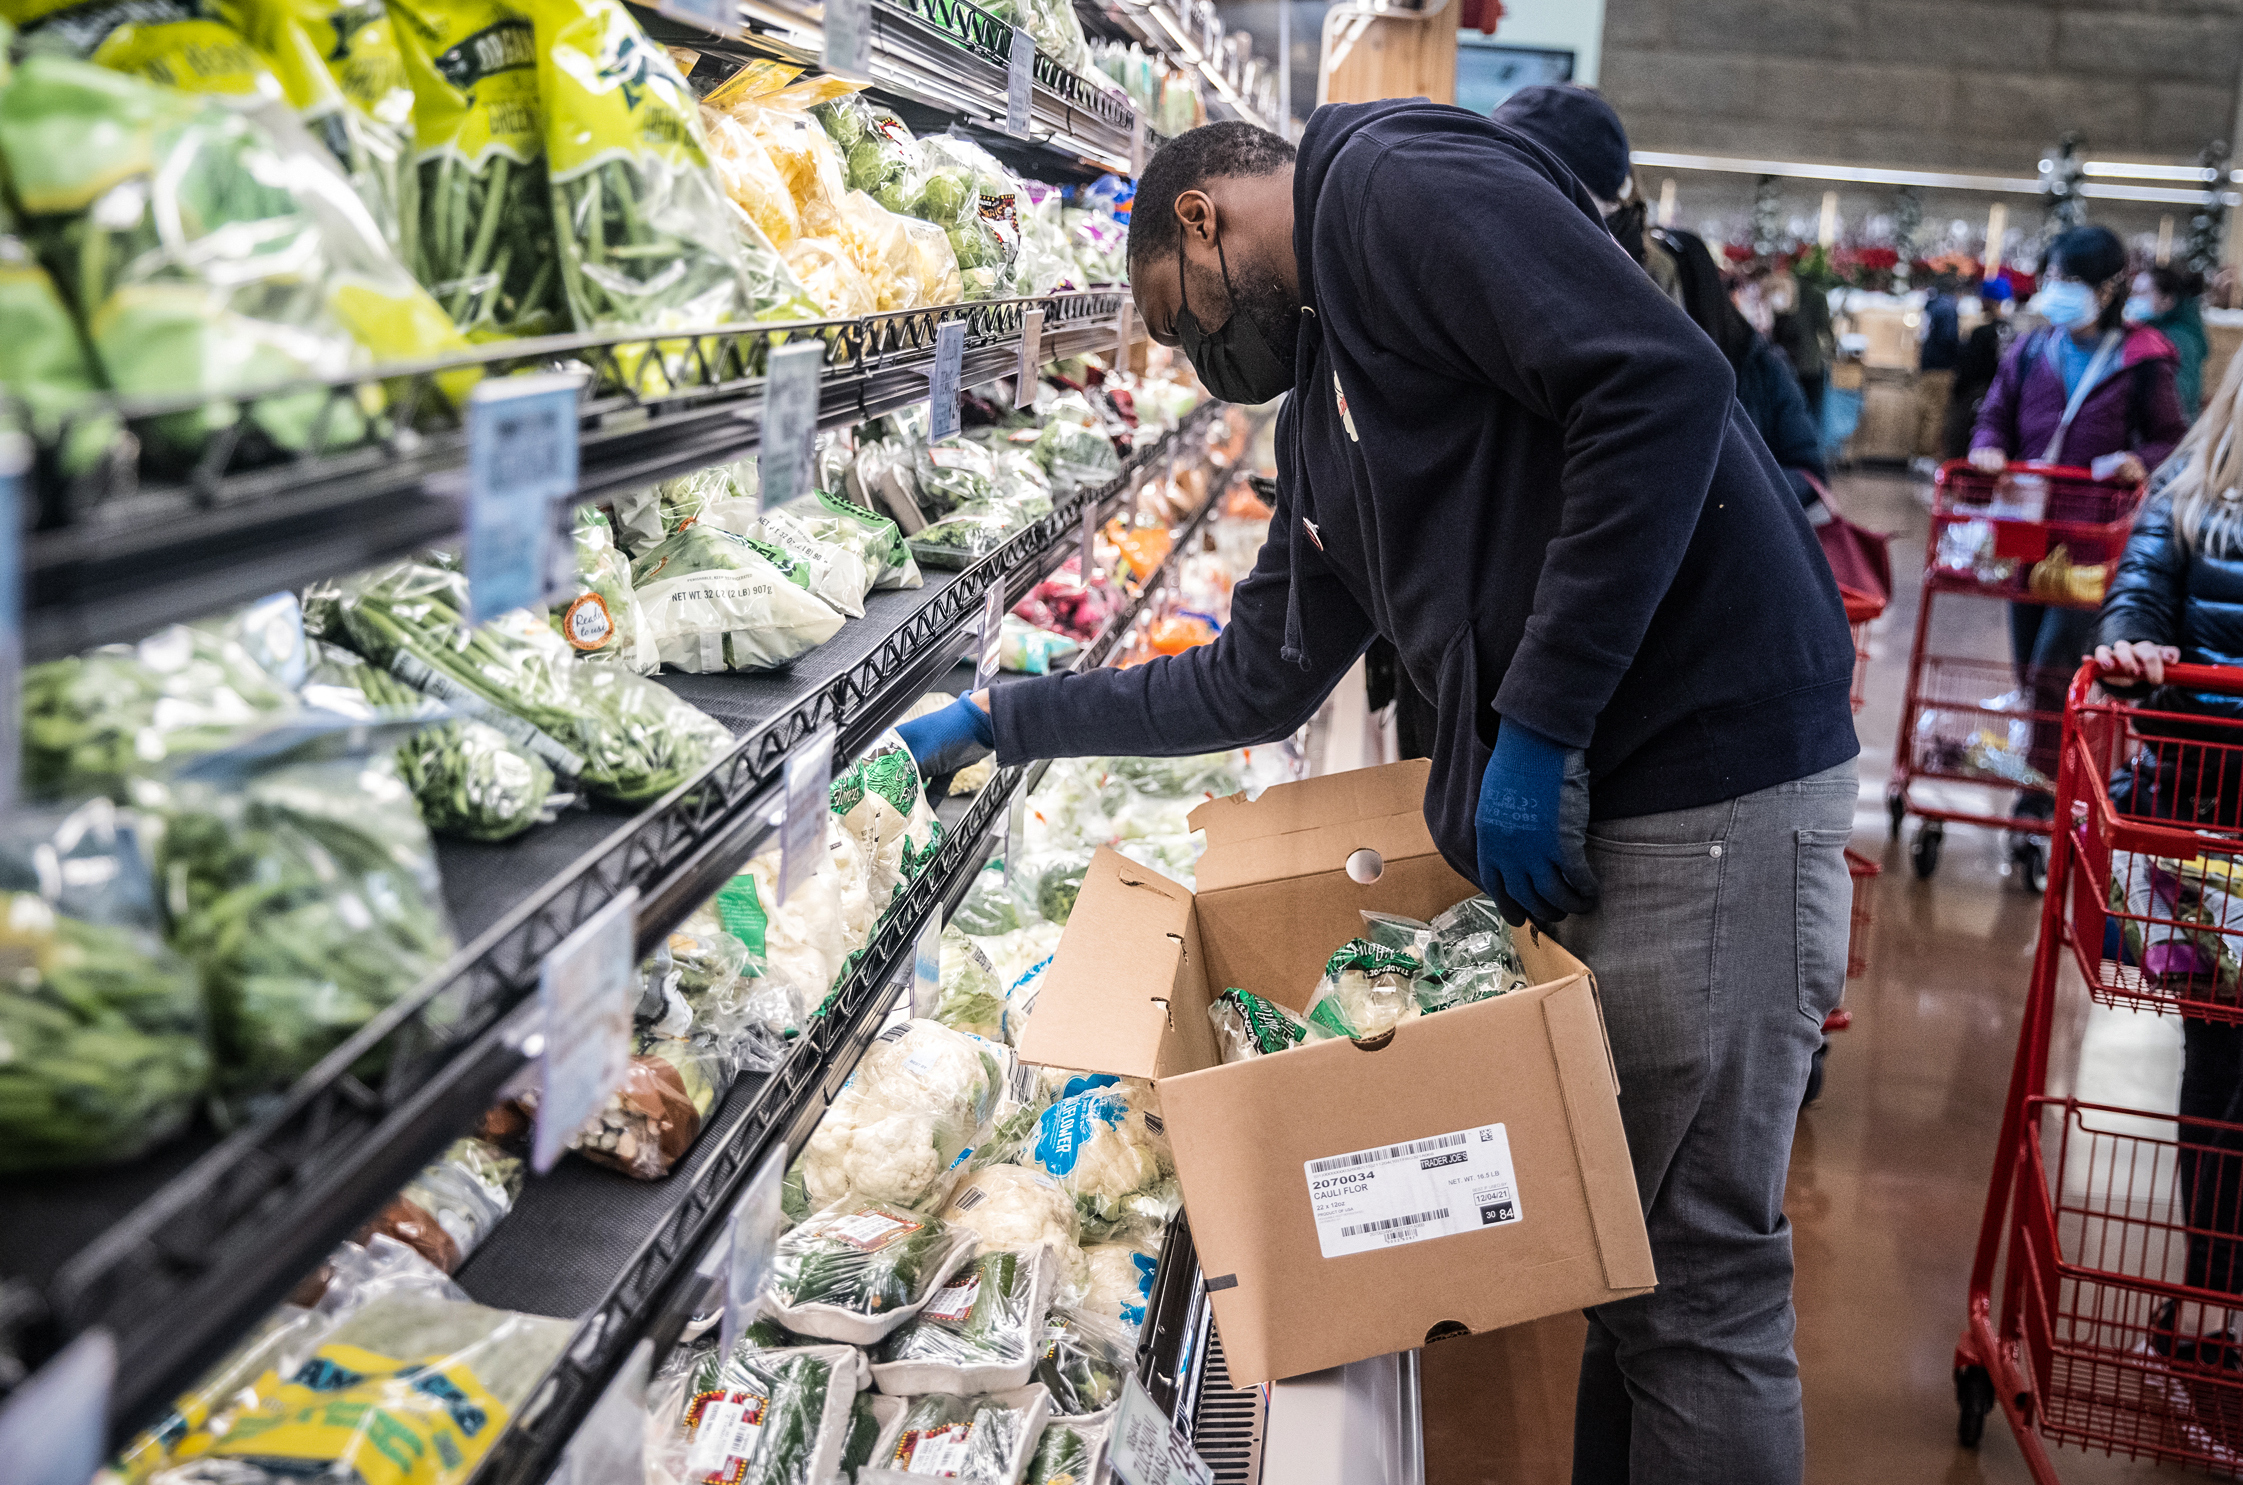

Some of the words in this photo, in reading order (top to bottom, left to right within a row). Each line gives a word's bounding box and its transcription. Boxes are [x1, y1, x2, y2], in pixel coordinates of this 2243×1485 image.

[779, 531, 788, 540] 32
[672, 591, 687, 602] NET
[704, 590, 714, 599] 32
[753, 585, 773, 595] 907g
[576, 607, 606, 627] Ready
[581, 627, 590, 637] to
[591, 625, 606, 634] use
[1420, 1155, 1450, 1169] TRADER
[1449, 1152, 1468, 1163] JOE'S
[1312, 1171, 1375, 1190] 2070034
[1448, 1177, 1463, 1186] NET.
[1464, 1175, 1476, 1183] WT.
[1477, 1172, 1490, 1180] 16.5
[1490, 1170, 1500, 1178] LB
[1313, 1188, 1342, 1200] CAULI
[1343, 1183, 1369, 1195] FLOR
[1475, 1190, 1507, 1203] 12/04/21
[1331, 1201, 1346, 1209] 12oz
[1317, 1210, 1338, 1218] PRODUCT
[1485, 1210, 1496, 1219] 30
[1499, 1207, 1514, 1220] 84
